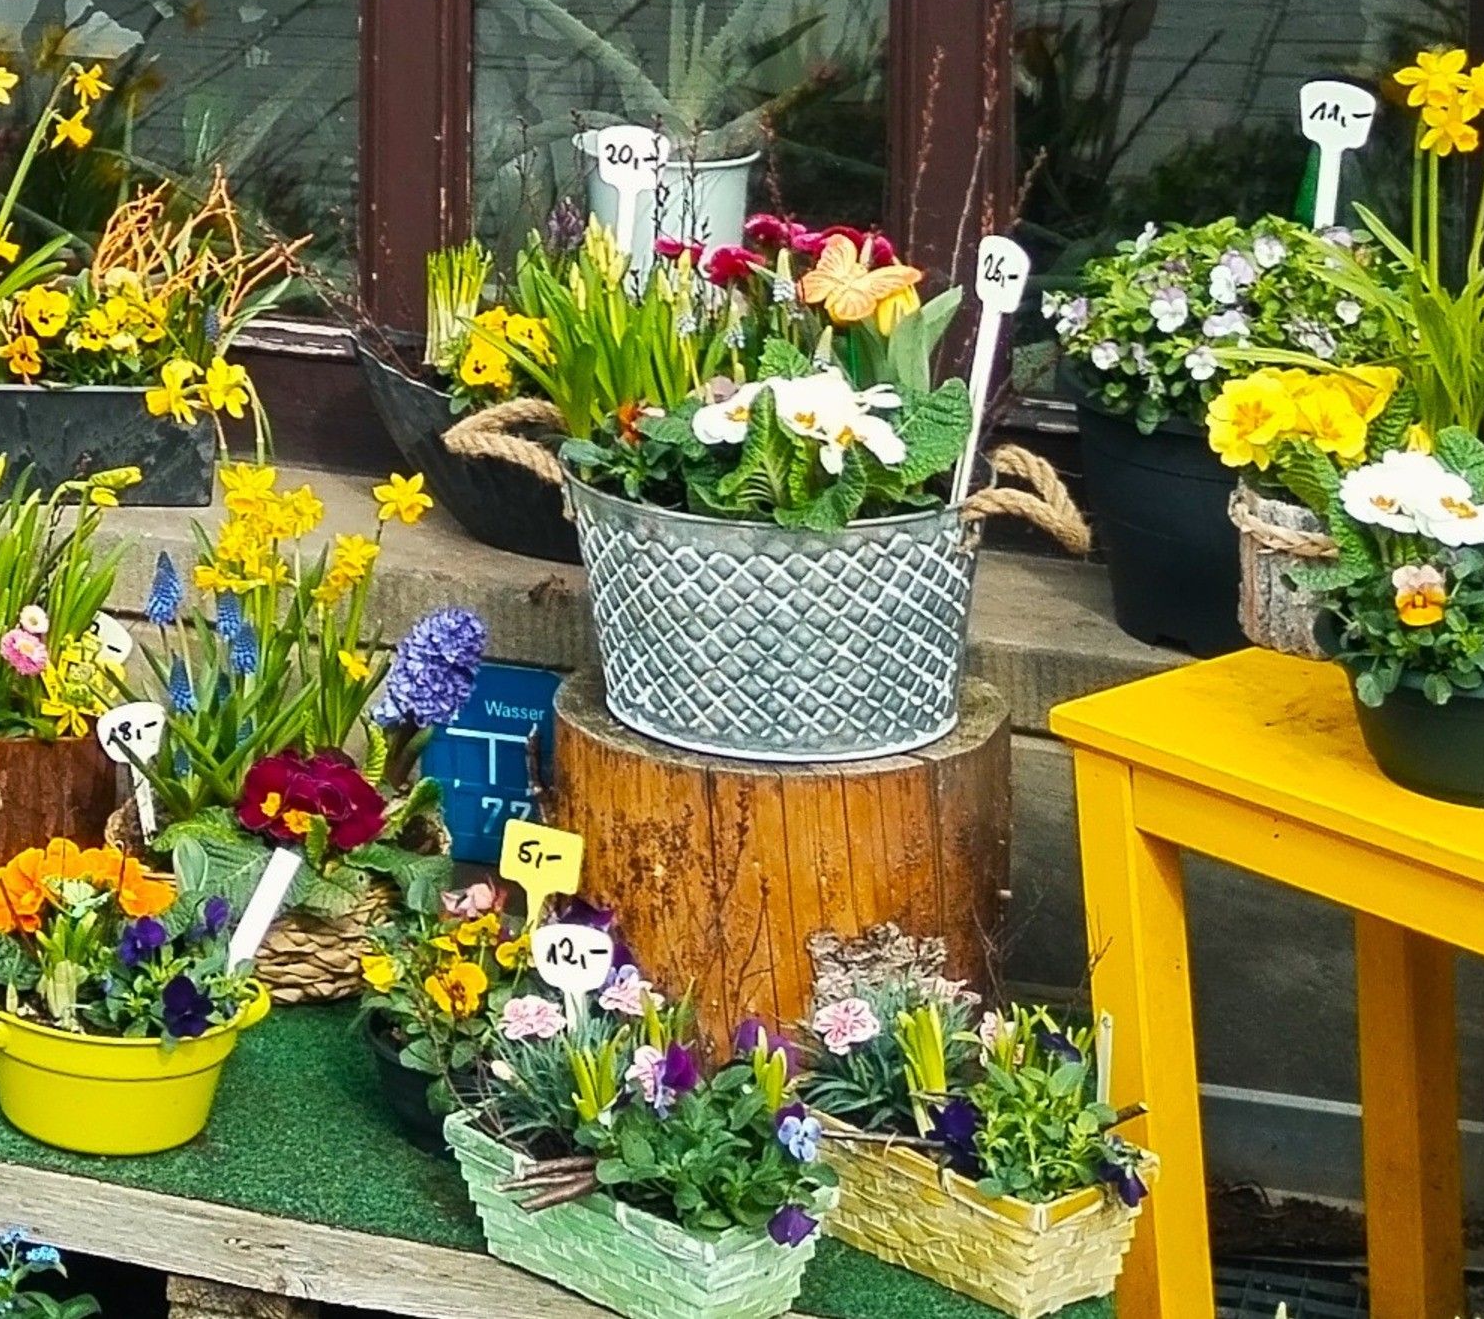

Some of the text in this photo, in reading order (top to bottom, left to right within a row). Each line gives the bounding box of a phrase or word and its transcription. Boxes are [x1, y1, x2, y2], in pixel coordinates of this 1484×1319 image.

[605, 143, 659, 170] 20,-
[485, 699, 546, 722] Wasser
[547, 937, 609, 970] 12,-
